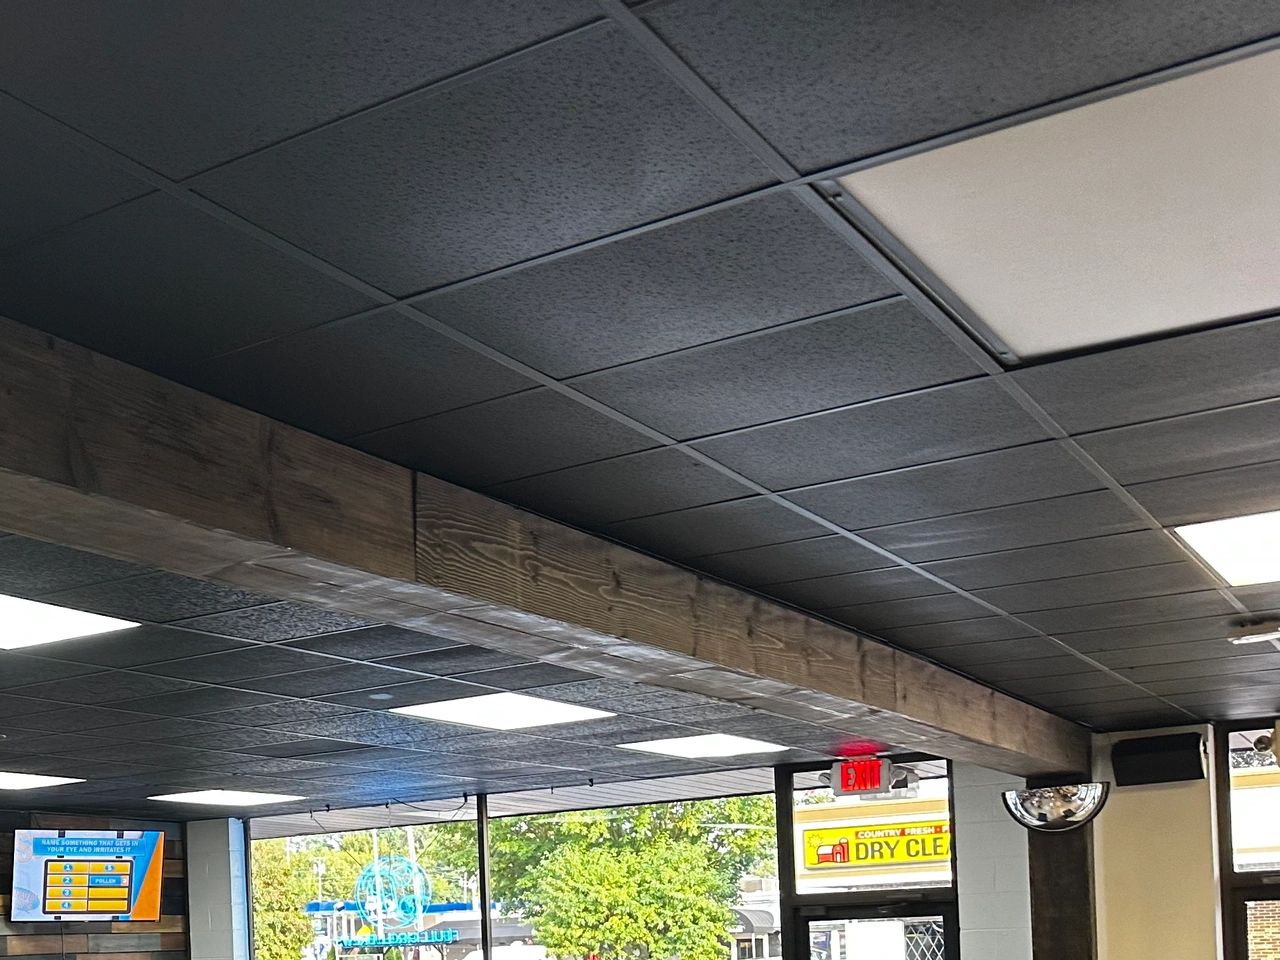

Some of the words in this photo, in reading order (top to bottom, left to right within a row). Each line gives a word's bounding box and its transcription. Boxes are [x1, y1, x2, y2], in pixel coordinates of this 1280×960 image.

[841, 760, 883, 792] EXIT
[857, 829, 902, 839] COUNTRY
[904, 826, 935, 836] FRESH
[855, 839, 901, 861] DRY
